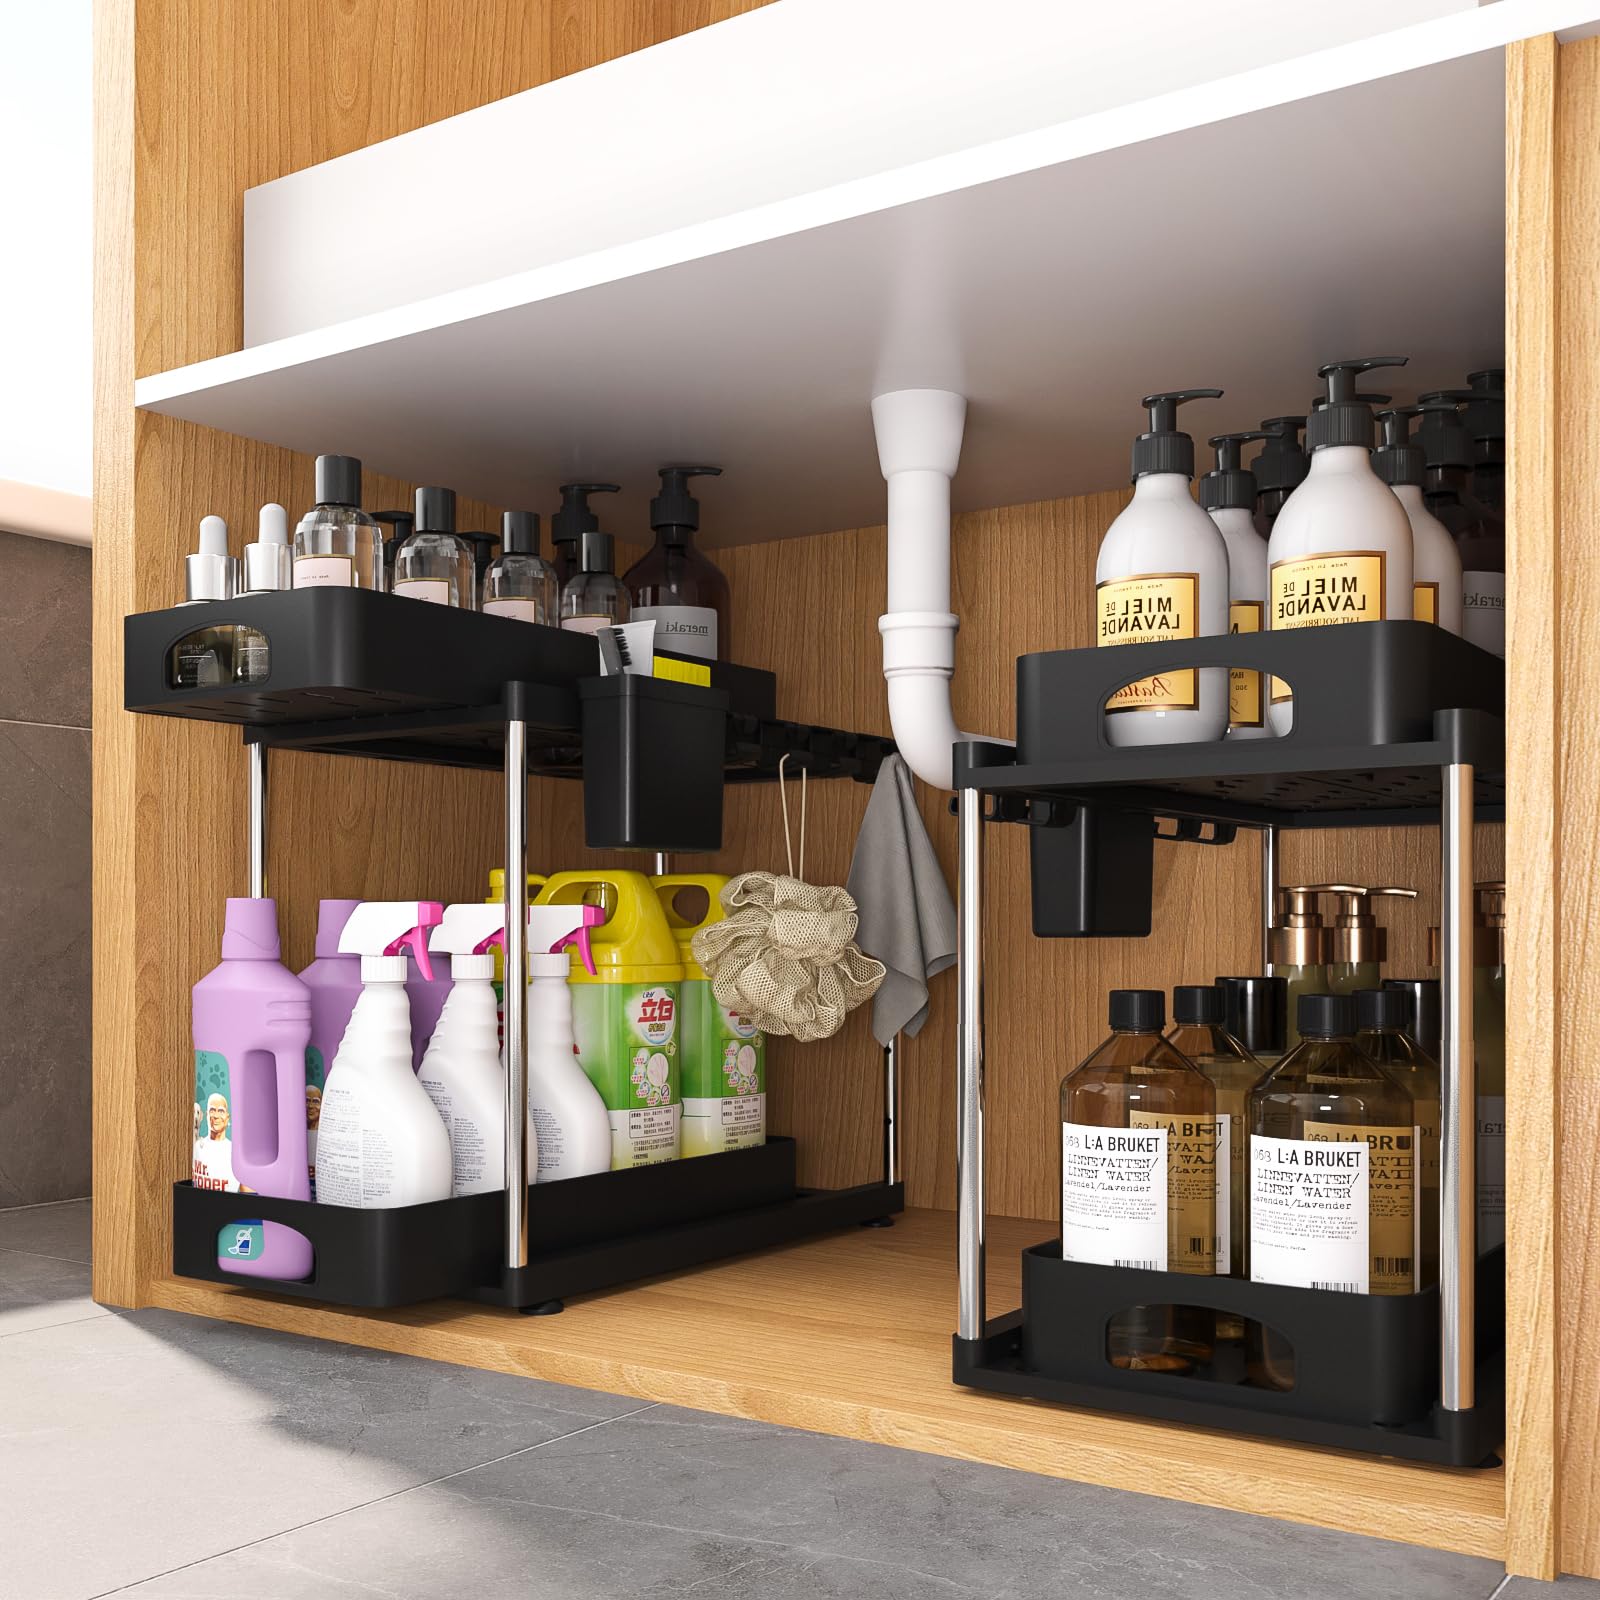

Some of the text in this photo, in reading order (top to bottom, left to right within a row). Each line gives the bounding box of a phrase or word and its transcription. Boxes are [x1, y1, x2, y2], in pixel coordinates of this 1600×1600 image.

[1085, 1134, 1103, 1151] L:A
[1108, 1136, 1160, 1153] BRUKET
[1278, 1148, 1299, 1165] L:A
[1304, 1150, 1361, 1168] BRUKET
[1106, 1170, 1151, 1182] WATER
[1302, 1186, 1352, 1198] WATER
